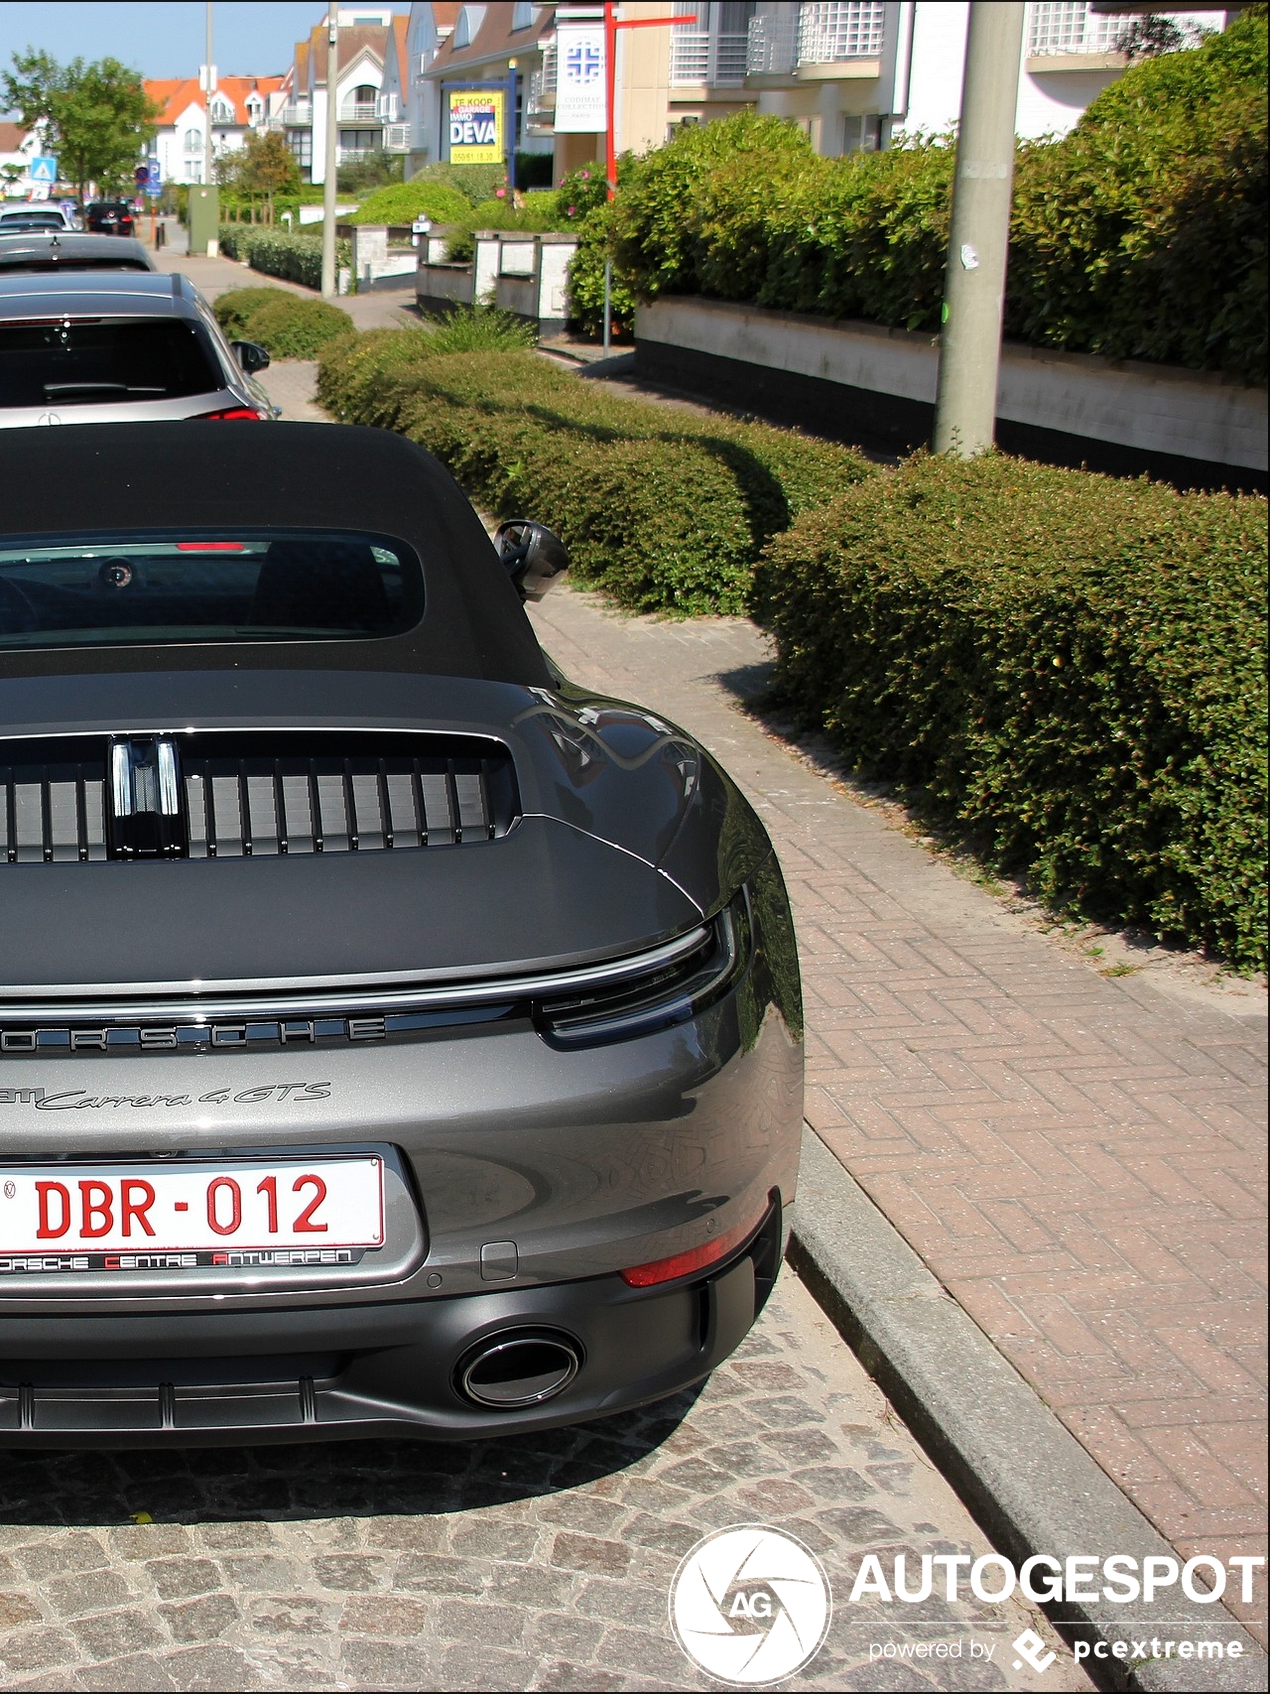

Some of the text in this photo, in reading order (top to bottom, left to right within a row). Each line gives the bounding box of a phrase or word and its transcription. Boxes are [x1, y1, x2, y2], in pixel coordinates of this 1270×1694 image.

[455, 98, 492, 107] TE KOOP
[450, 112, 472, 121] IMMO
[450, 121, 496, 144] DEVA
[34, 1089, 193, 1111] Carrera
[233, 1081, 331, 1103] GTS
[104, 1253, 197, 1269] CENTRE
[212, 1249, 353, 1266] ANTWERPEN
